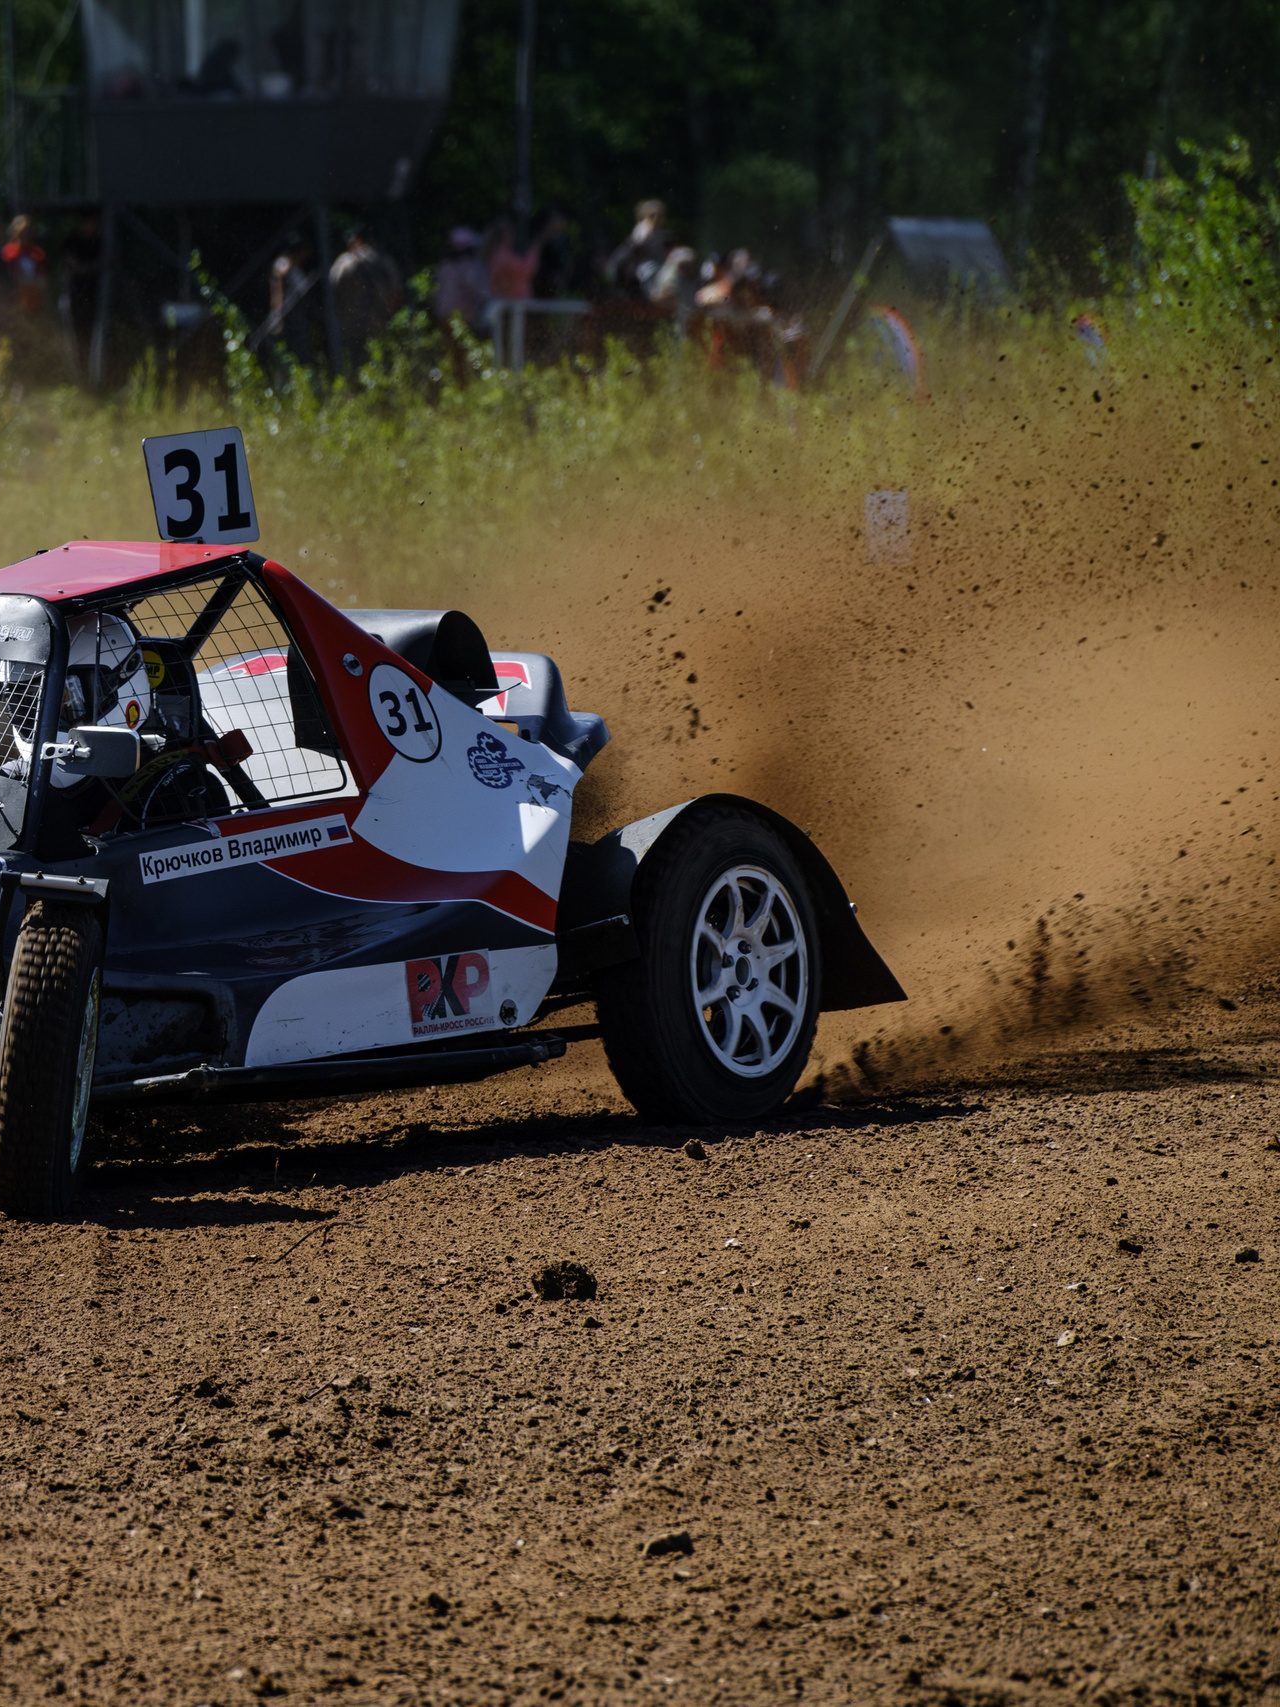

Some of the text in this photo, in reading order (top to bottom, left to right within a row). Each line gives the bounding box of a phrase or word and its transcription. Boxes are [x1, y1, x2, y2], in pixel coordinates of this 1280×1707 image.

[164, 443, 251, 538] 31
[145, 664, 160, 676] MP
[379, 687, 434, 737] 31
[142, 827, 323, 879] Крючков Владимир
[413, 1020, 464, 1036] РАЛЛИ-КРОСС
